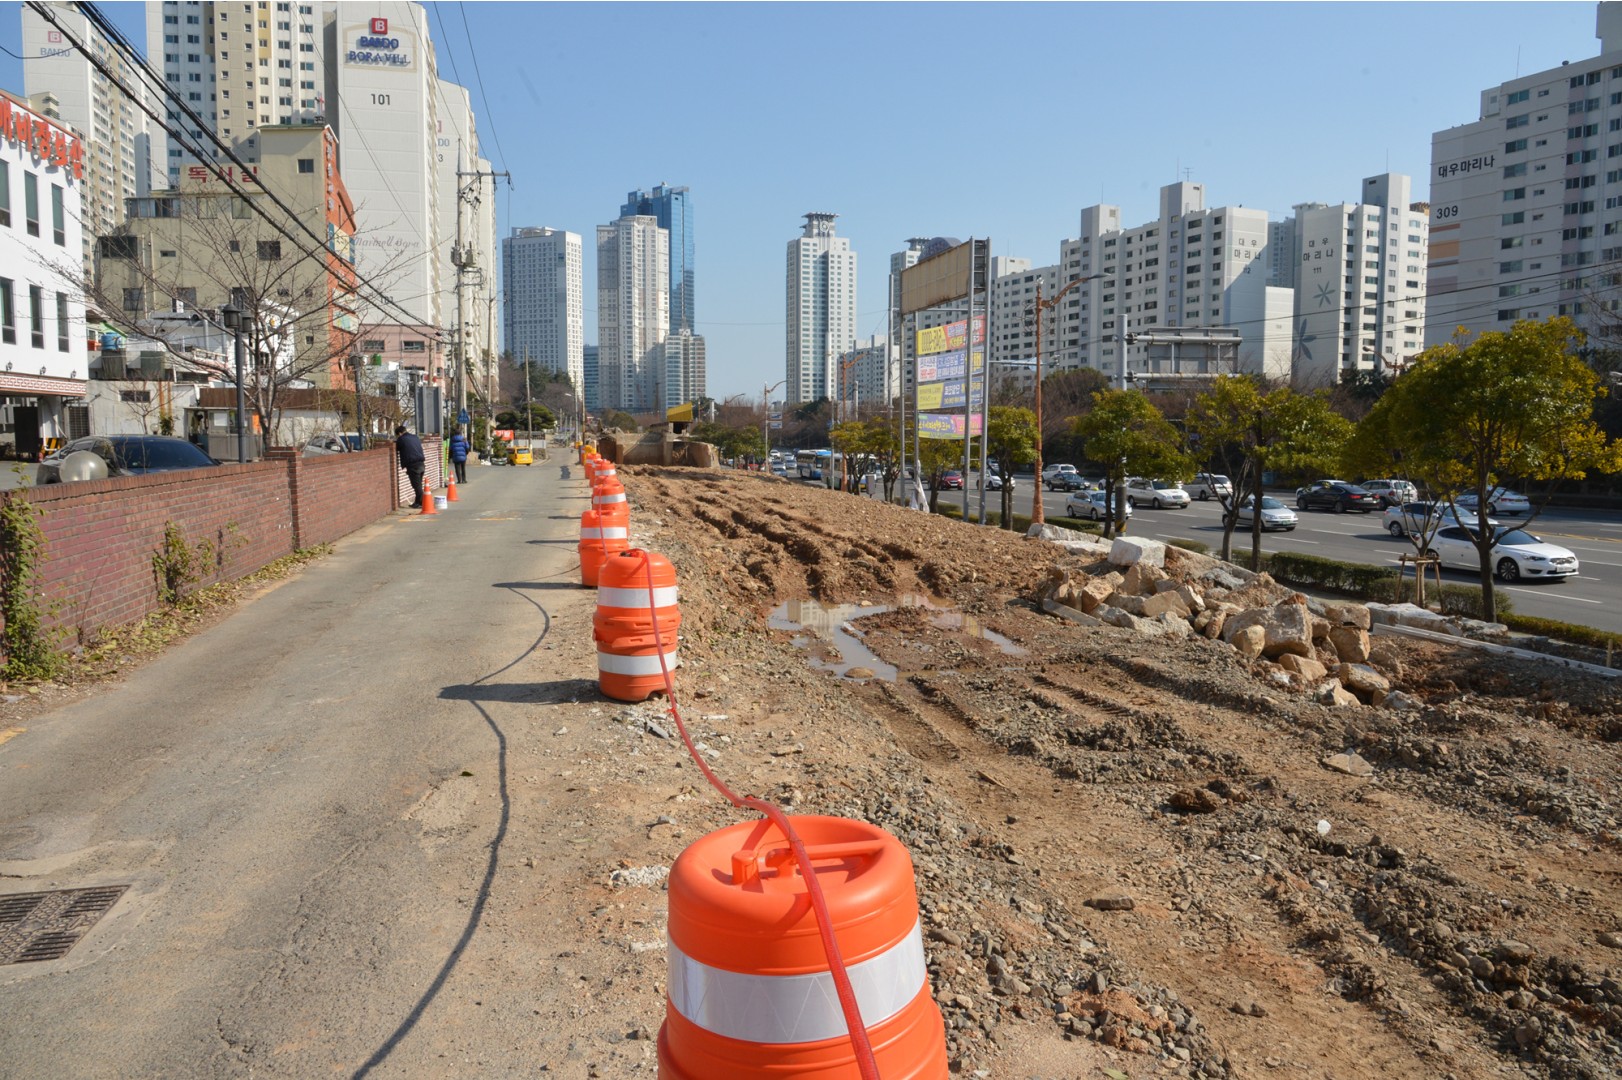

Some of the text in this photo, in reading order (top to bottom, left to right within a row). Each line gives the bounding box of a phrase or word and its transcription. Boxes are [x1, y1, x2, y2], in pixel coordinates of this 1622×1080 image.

[360, 36, 399, 49] BANDO
[40, 48, 71, 57] BANDO
[371, 93, 391, 106] 101
[1438, 154, 1496, 178] 대우마리나
[1436, 205, 1459, 220] 309
